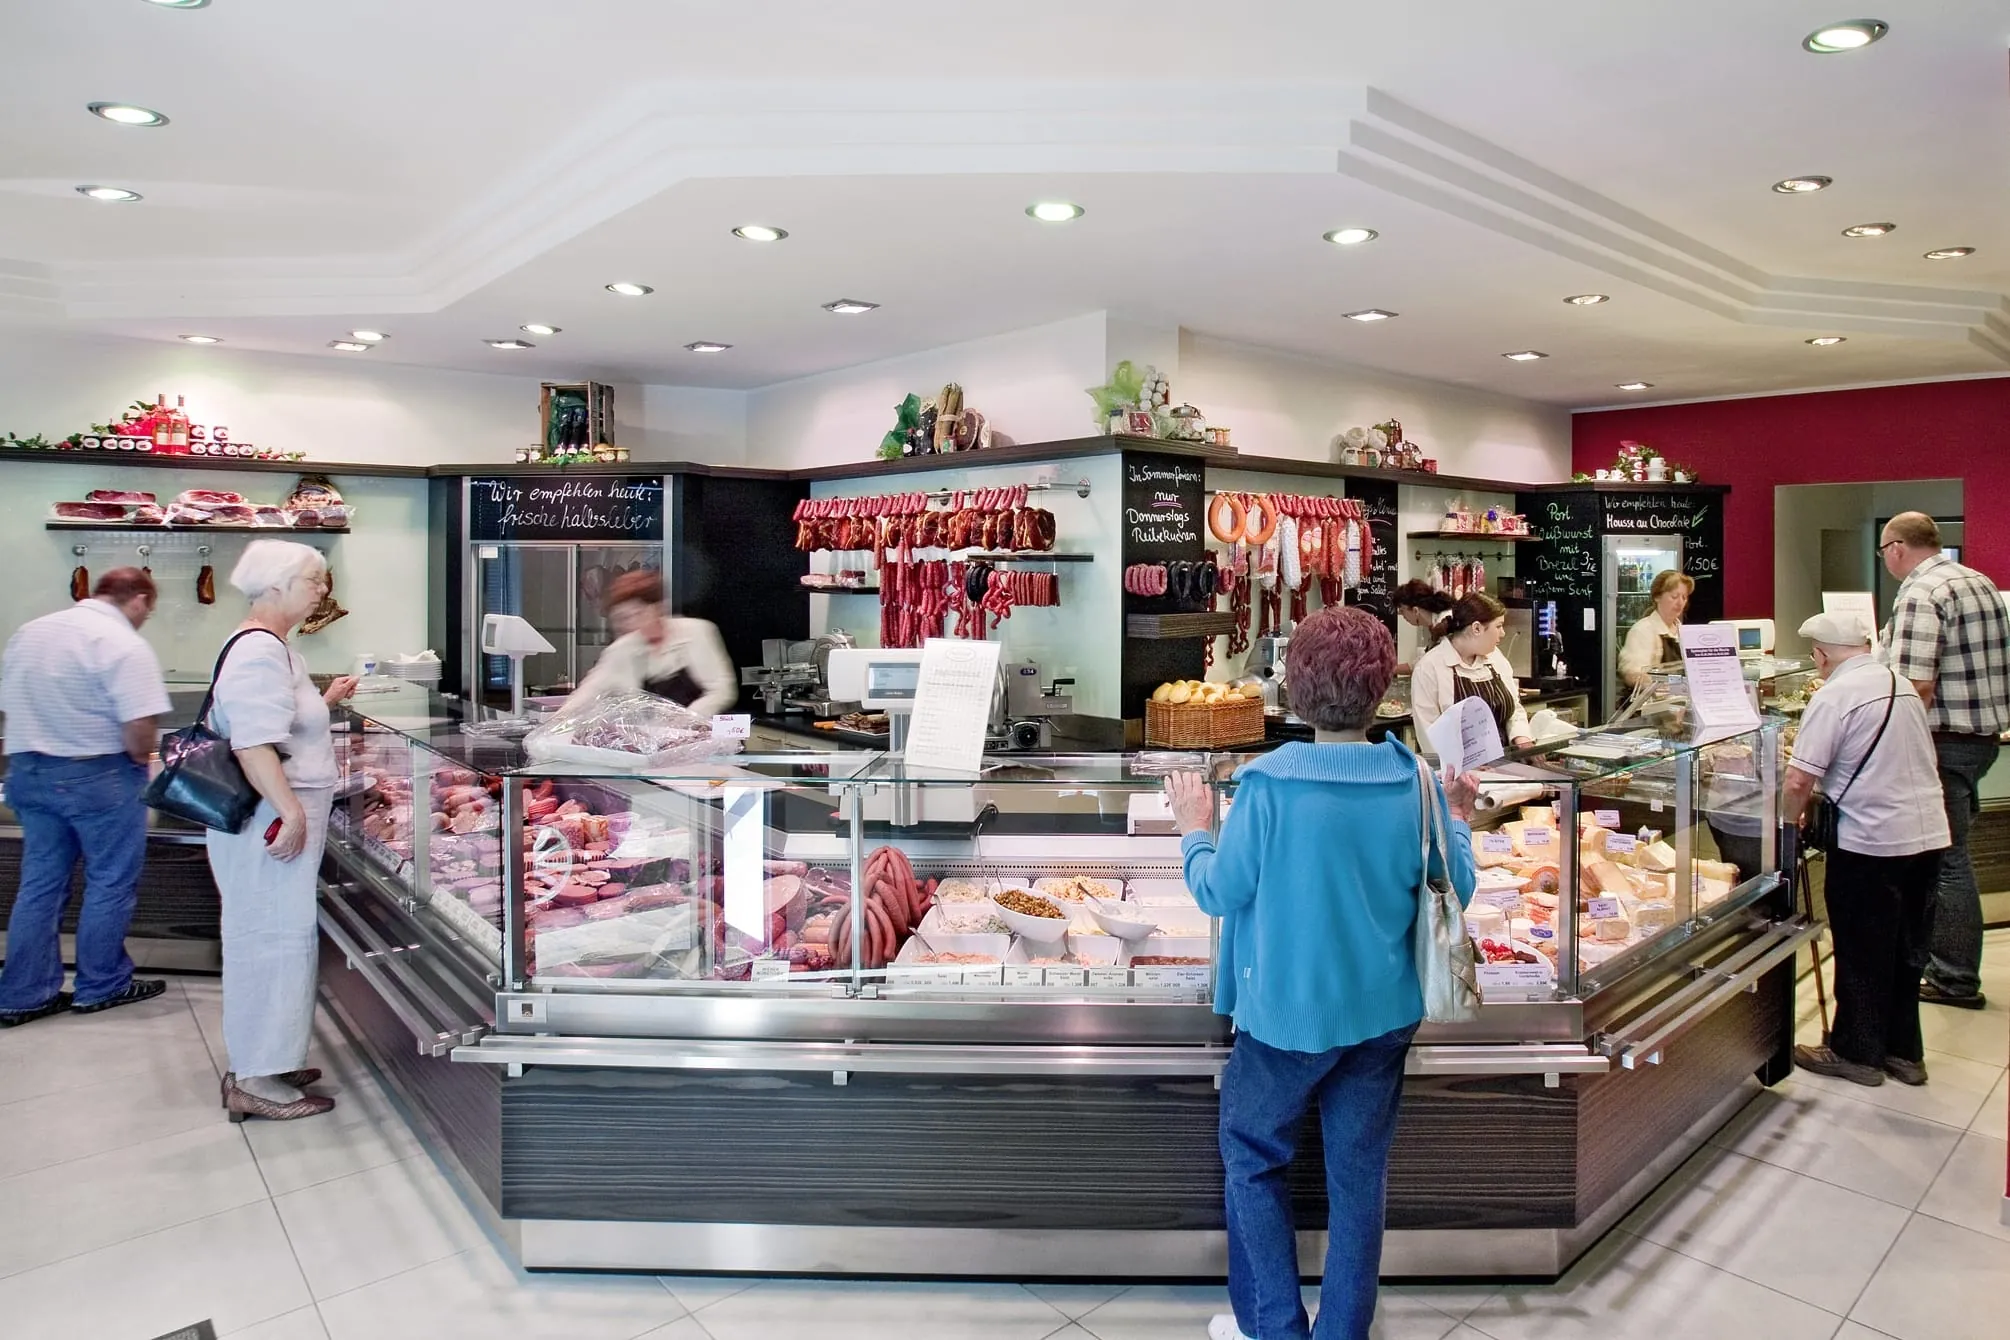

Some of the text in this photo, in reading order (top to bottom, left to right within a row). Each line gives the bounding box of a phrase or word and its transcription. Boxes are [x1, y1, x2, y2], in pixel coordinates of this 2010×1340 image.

[489, 479, 653, 504] Wir empfehlen heute:
[1154, 491, 1180, 502] nur
[1546, 502, 1574, 521] Port.
[1604, 495, 1620, 509] Wir
[1621, 495, 1667, 511] empfehlen
[497, 503, 559, 535] frische
[1125, 508, 1190, 529] Donnerstags
[1636, 519, 1648, 529] au
[1649, 514, 1691, 529] Chocolate
[1559, 542, 1580, 554] mit
[1683, 535, 1709, 550] Port.
[1568, 582, 1593, 600] Senf
